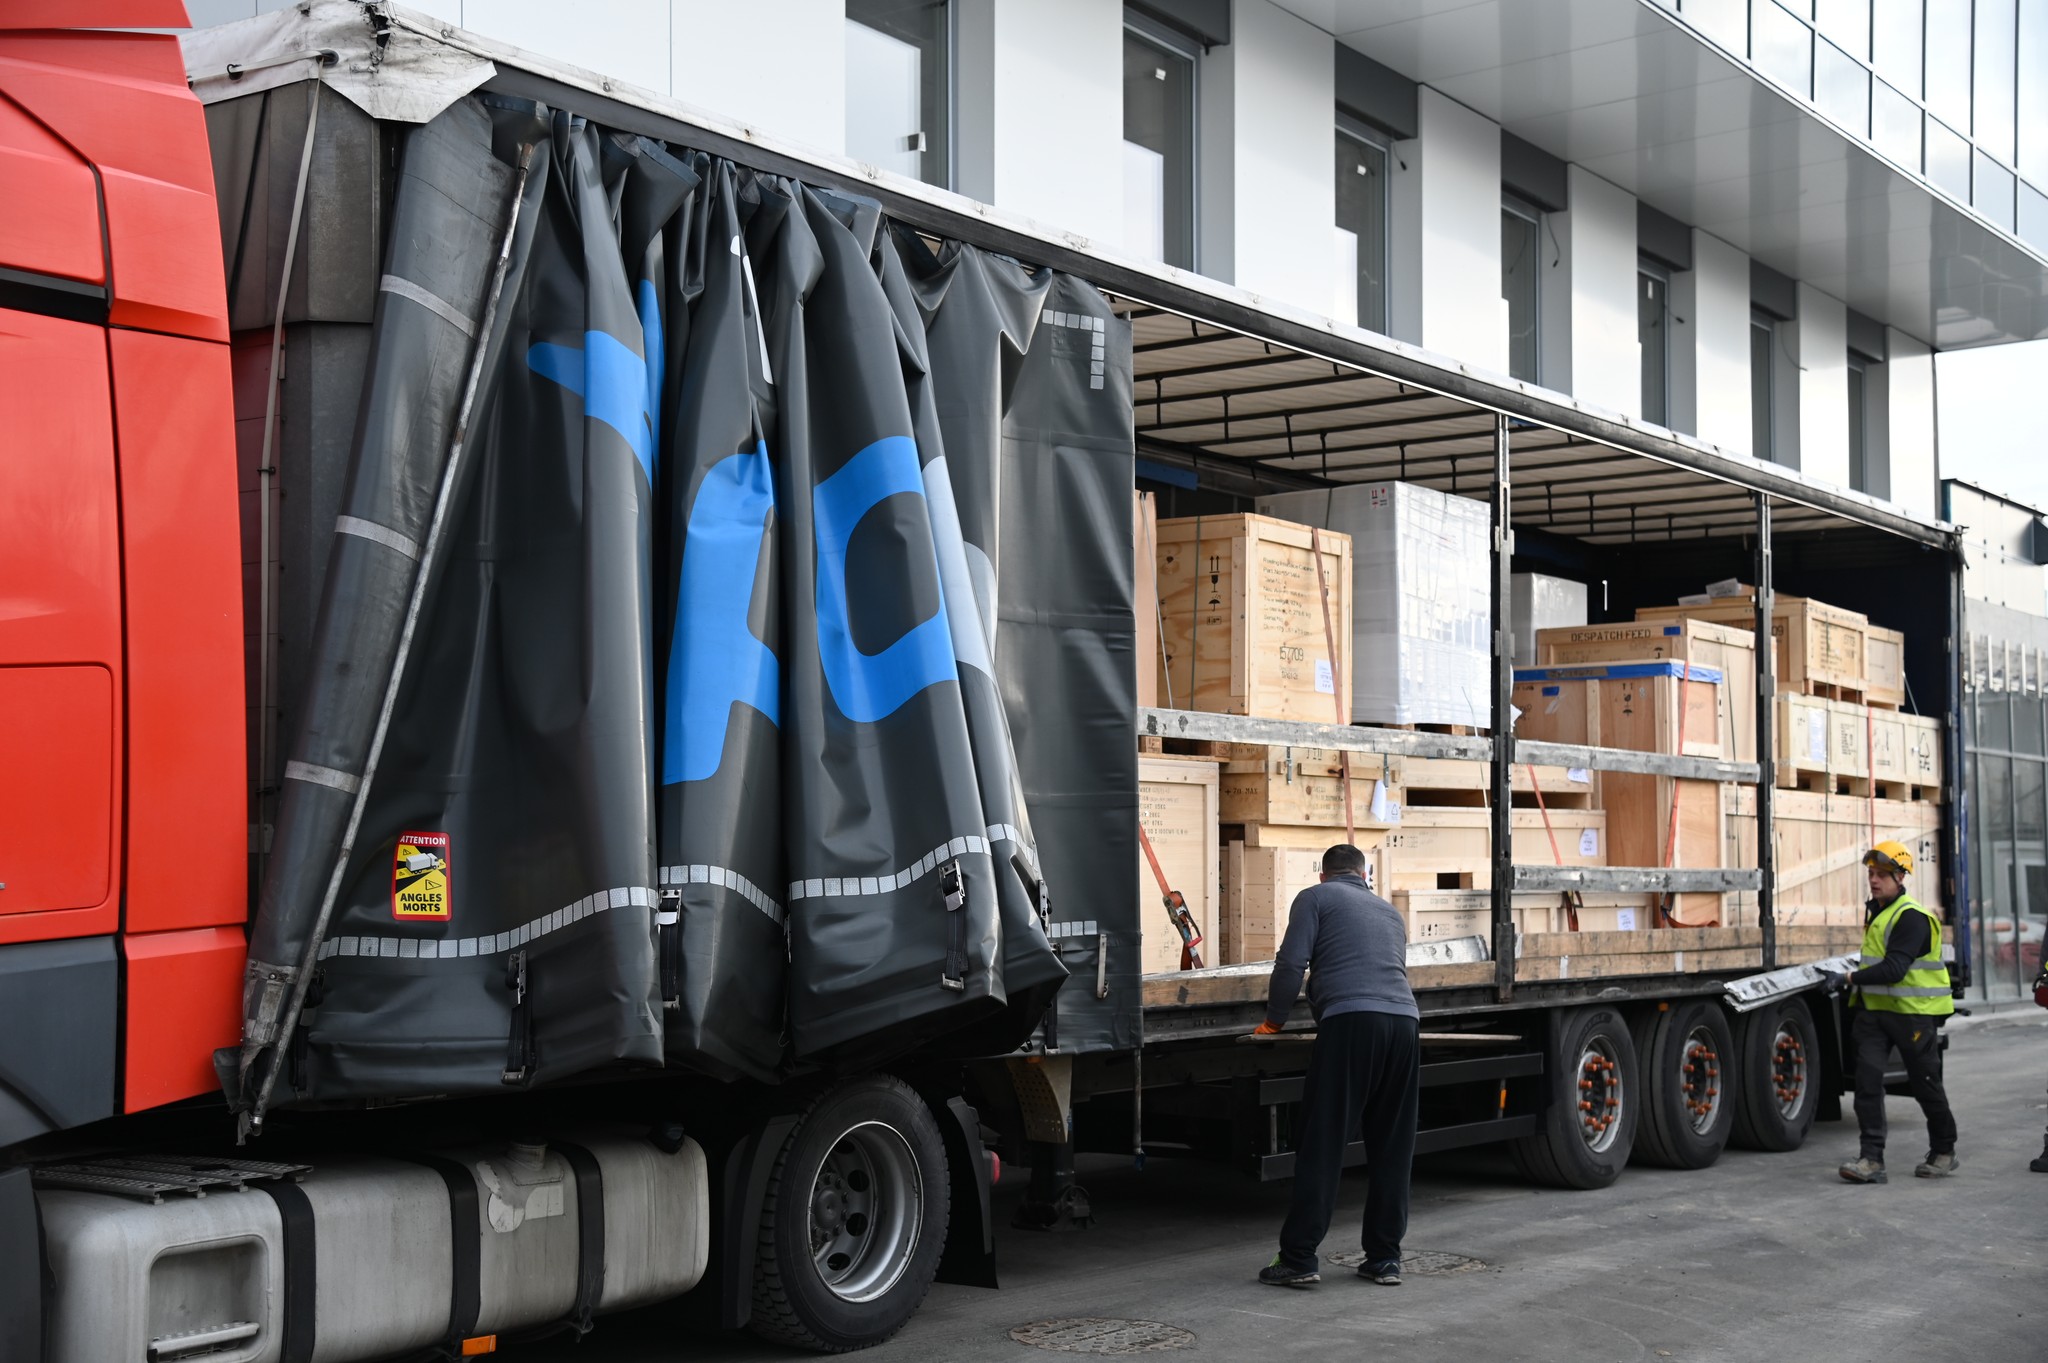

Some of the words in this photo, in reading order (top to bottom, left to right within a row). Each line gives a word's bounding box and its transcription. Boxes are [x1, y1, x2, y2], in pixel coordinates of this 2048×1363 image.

[1570, 630, 1623, 642] DESPATCH
[1625, 628, 1652, 640] FEED
[1244, 787, 1258, 796] MAX
[400, 835, 446, 845] ATTENTION
[1312, 860, 1322, 873] BA
[400, 893, 442, 902] ANGLES
[403, 903, 441, 912] MORTS
